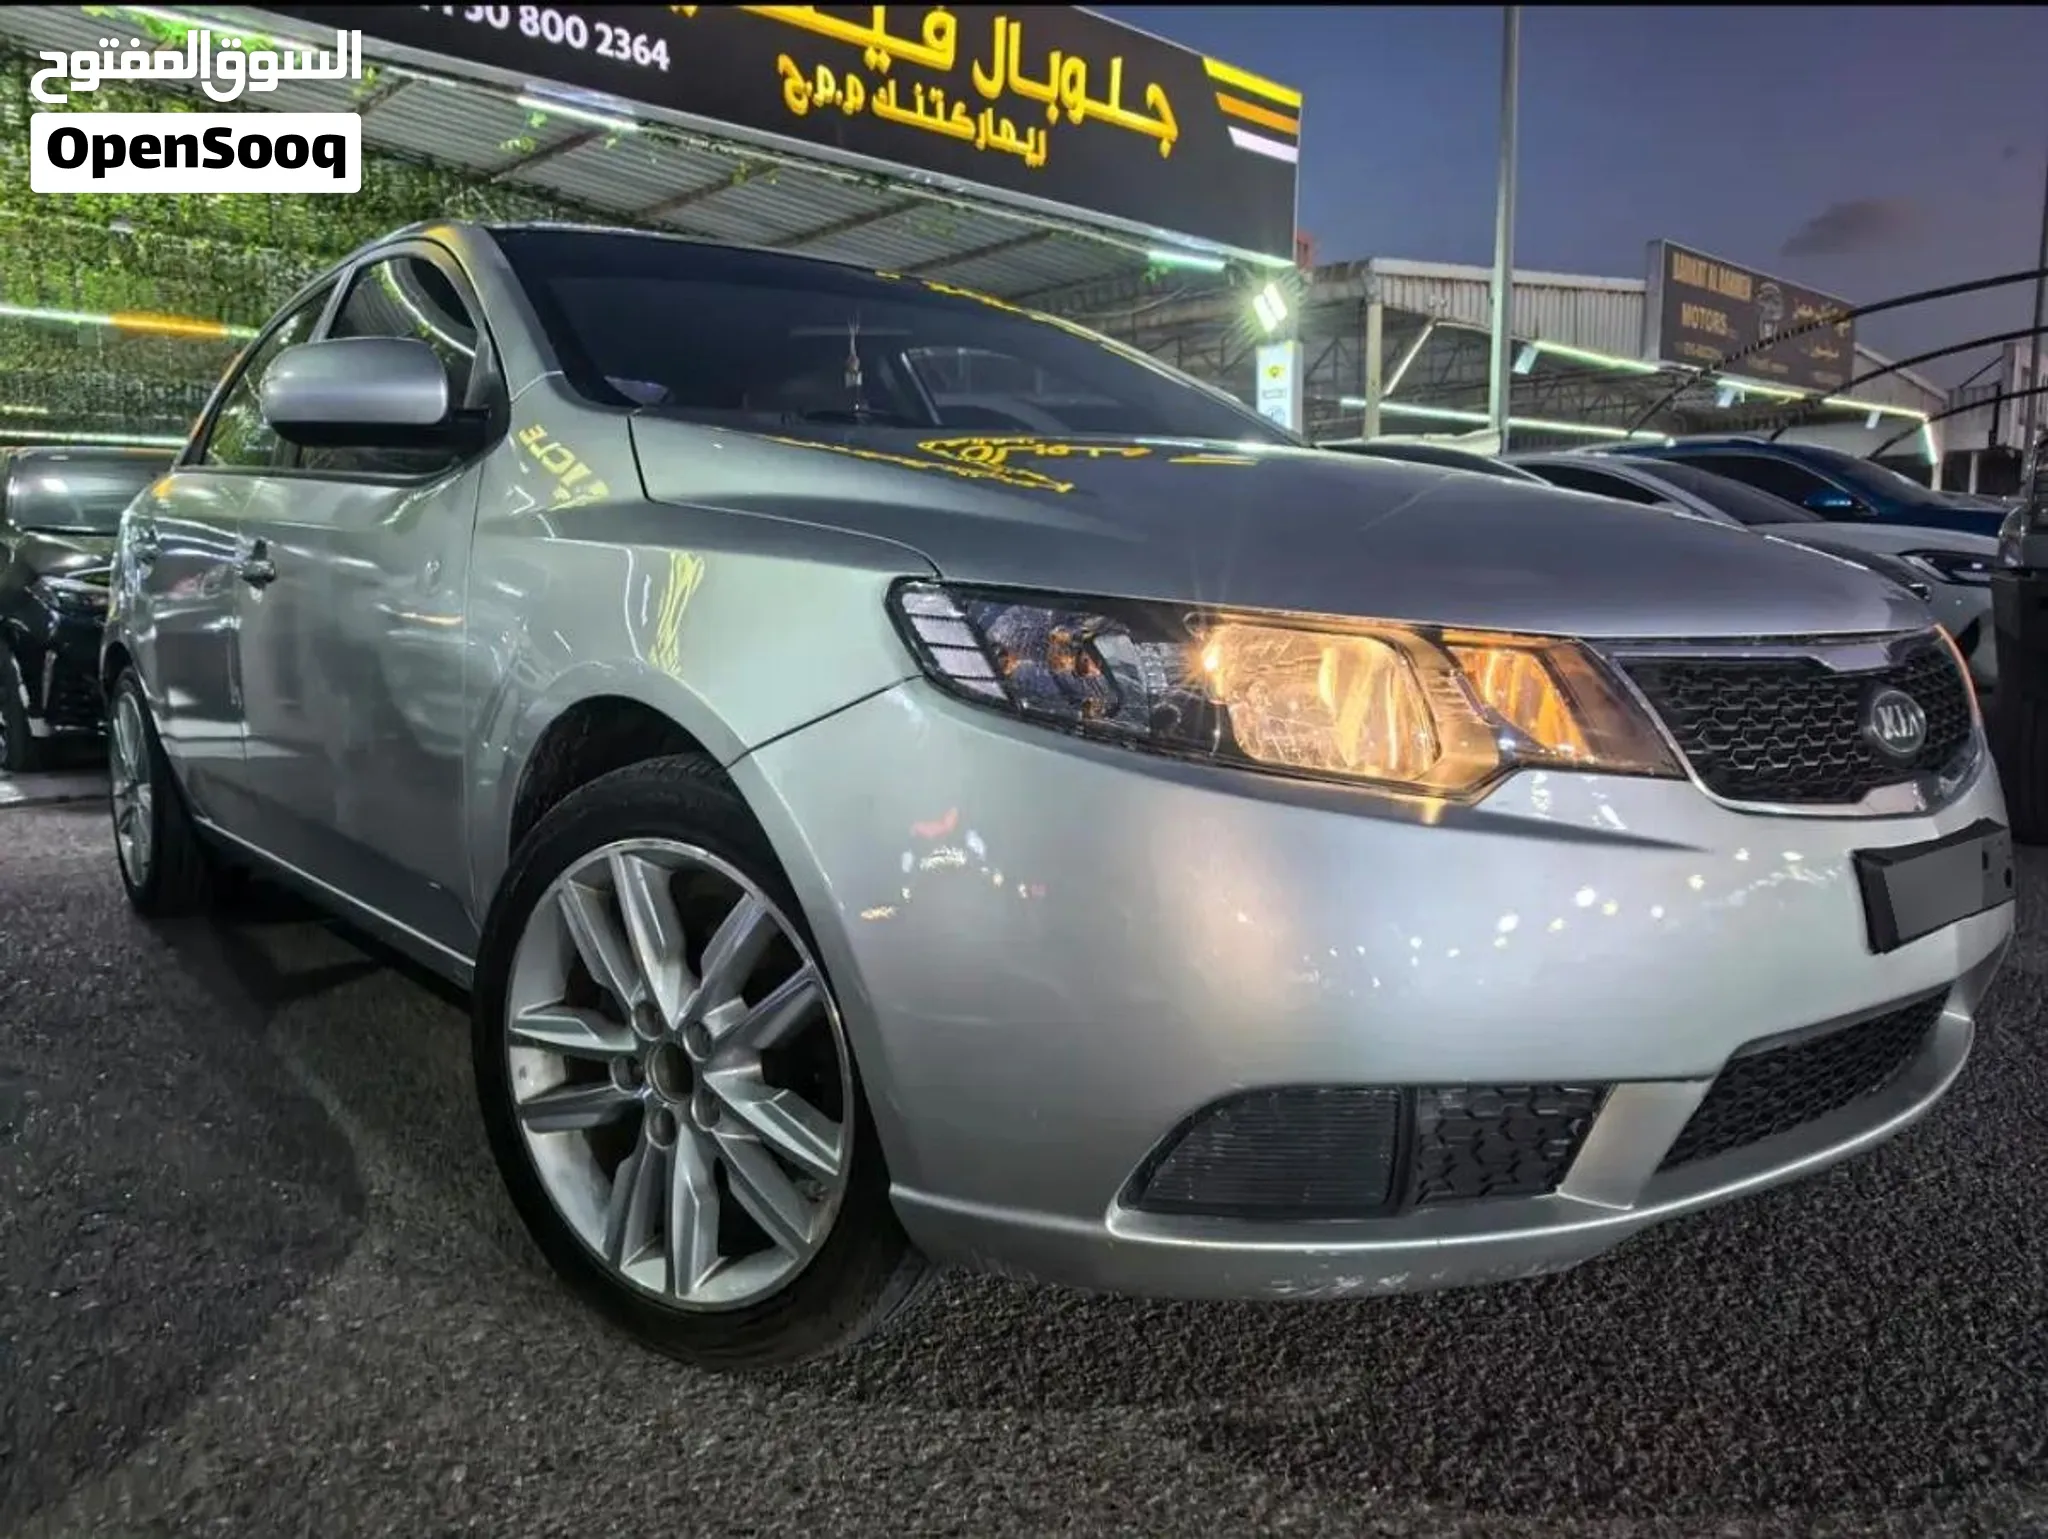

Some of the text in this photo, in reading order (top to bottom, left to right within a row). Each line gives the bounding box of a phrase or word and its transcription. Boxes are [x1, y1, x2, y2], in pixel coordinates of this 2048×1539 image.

[519, 5, 588, 49] 800
[595, 23, 670, 71] 2364
[972, 16, 1178, 158] جلوبال
[1877, 704, 1921, 741] KIA
